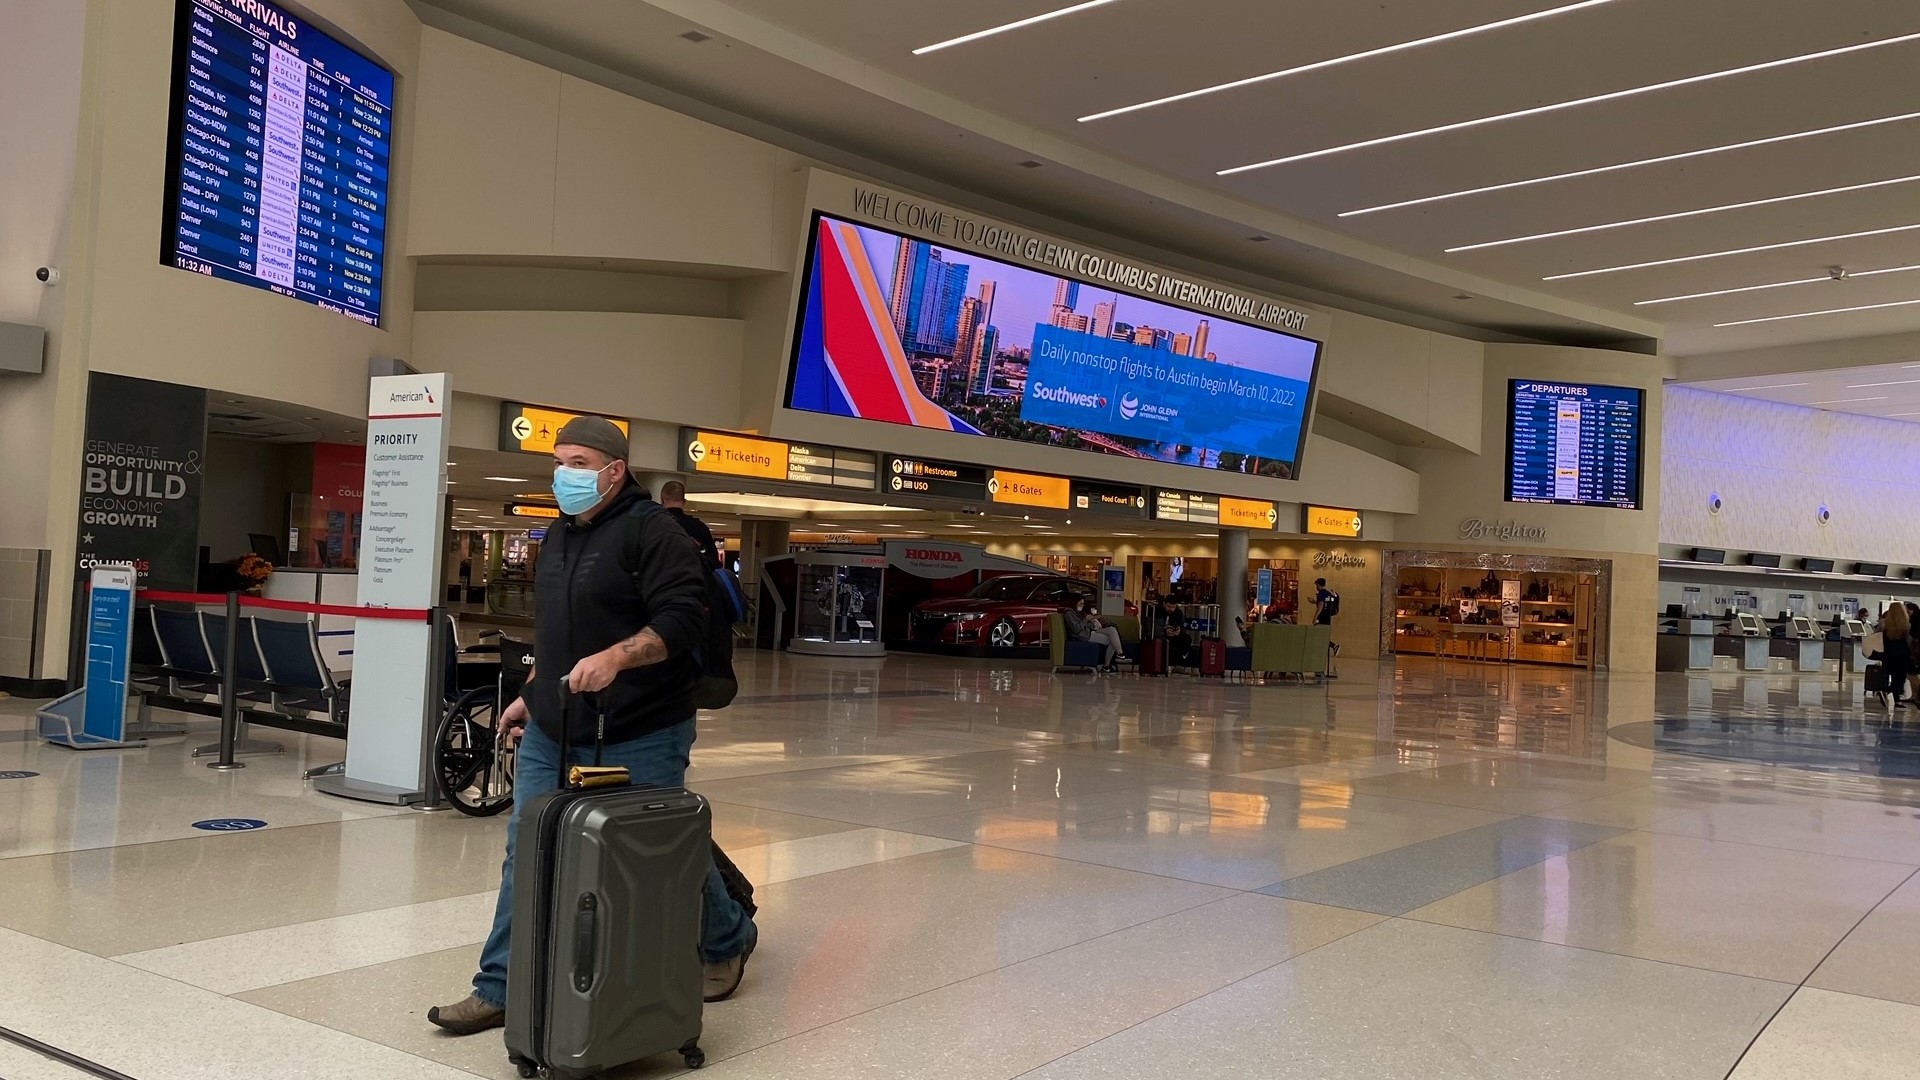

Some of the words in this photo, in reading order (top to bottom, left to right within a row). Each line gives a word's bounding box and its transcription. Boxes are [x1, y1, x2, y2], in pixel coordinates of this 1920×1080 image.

[225, 9, 242, 24] FROM
[229, 0, 297, 40] RRIVALS
[194, 6, 213, 24] Atlanta
[281, 54, 301, 71] DELTA
[249, 23, 269, 40] FLIGHT
[193, 20, 212, 38] Atlanta
[251, 52, 264, 65] 1540
[281, 68, 301, 84] DELTA
[278, 39, 299, 56] AIRLINE
[192, 35, 218, 56] Baltimore
[250, 66, 260, 77] 974
[272, 77, 300, 98] Southwest
[312, 58, 324, 70] TIME
[191, 50, 211, 67] Boston
[279, 95, 299, 110] DELTA
[335, 70, 350, 85] CLAIM
[217, 92, 226, 104] NC
[360, 85, 377, 100] STATUS
[190, 65, 210, 81] Boston
[317, 127, 325, 137] PM
[357, 146, 363, 155] On
[364, 150, 374, 161] Time
[188, 94, 228, 121] Chicago-MDW
[269, 131, 296, 150] Southwest
[187, 109, 227, 135] Chicago-MDW
[268, 144, 296, 164] Southwest
[266, 173, 289, 187] UNITED
[313, 192, 321, 201] PM
[184, 167, 201, 181] Dallas
[206, 176, 220, 189] DFW
[242, 190, 256, 202] 1279
[313, 218, 321, 228] AM
[243, 177, 257, 189] 3719
[352, 221, 358, 229] On
[359, 224, 369, 234] Time
[183, 182, 200, 196] Dallas
[205, 191, 219, 203] DFW
[241, 204, 255, 216] 1443
[310, 231, 318, 240] PM
[182, 197, 199, 210] Dallas
[200, 204, 218, 219] (Love)
[263, 226, 291, 243] Southwest
[181, 212, 201, 226] Denver
[262, 241, 285, 254] UNITED
[309, 257, 317, 266] PM
[180, 227, 200, 241] Denver
[239, 246, 249, 257] 702
[261, 253, 289, 270] Southwest
[177, 256, 197, 272] 11:32
[199, 263, 212, 276] AM
[855, 188, 951, 237] WELCOME
[954, 216, 976, 243] TO
[977, 224, 1024, 256] JOHN
[1024, 238, 1078, 272] GLENN
[1078, 253, 1158, 292] COLUMBUS
[1157, 276, 1256, 319] INTERNATIONAL
[1257, 303, 1310, 331] AIRPORT
[179, 241, 198, 255] Detroit
[268, 270, 288, 283] DELTA
[347, 296, 354, 304] On
[355, 298, 365, 307] Time
[270, 284, 282, 294] PAGE
[344, 308, 372, 324] November
[374, 317, 377, 326] 1
[1040, 339, 1070, 366] Daily
[1072, 351, 1118, 374] nonstop
[1120, 356, 1153, 380] flights
[1155, 365, 1166, 381] to
[1167, 367, 1199, 388] Austin
[1200, 373, 1227, 395] begin
[1227, 379, 1256, 399] March
[1258, 385, 1269, 403] 10,
[1270, 388, 1296, 406] 2022
[390, 392, 423, 402] American
[1032, 382, 1098, 408] Southwest
[1532, 384, 1588, 396] DEPARTURES
[1139, 412, 1169, 422] INTERNATIONAL
[1140, 403, 1157, 413] JOHN
[1158, 406, 1178, 417] GLENN
[374, 433, 418, 445] PRIORITY
[87, 440, 159, 458] GENERATE
[398, 453, 424, 461] Assistance
[790, 446, 809, 455] Alaska
[86, 452, 183, 472] OPPORTUNITY
[184, 450, 202, 474] &
[725, 449, 770, 468] Ticketing
[789, 455, 816, 465] American
[790, 463, 805, 472] Delta
[924, 465, 957, 477] Restrooms
[85, 467, 187, 500] BUILD
[789, 472, 811, 482] Frontier
[338, 489, 362, 497] COLU
[913, 481, 928, 491] USO
[1013, 485, 1018, 493] B
[1020, 485, 1042, 496] Gates
[83, 497, 163, 514] ECONOMIC
[1101, 494, 1114, 503] Food
[1114, 496, 1128, 505] Court
[83, 511, 157, 528] GROWTH
[1231, 508, 1257, 520] Ticketing
[1317, 517, 1323, 525] A
[1324, 518, 1342, 527] Gates
[1458, 517, 1548, 541] Brighton
[904, 549, 963, 562] HONDA
[1312, 550, 1365, 567] Brighton
[1818, 603, 1850, 611] UNITED
